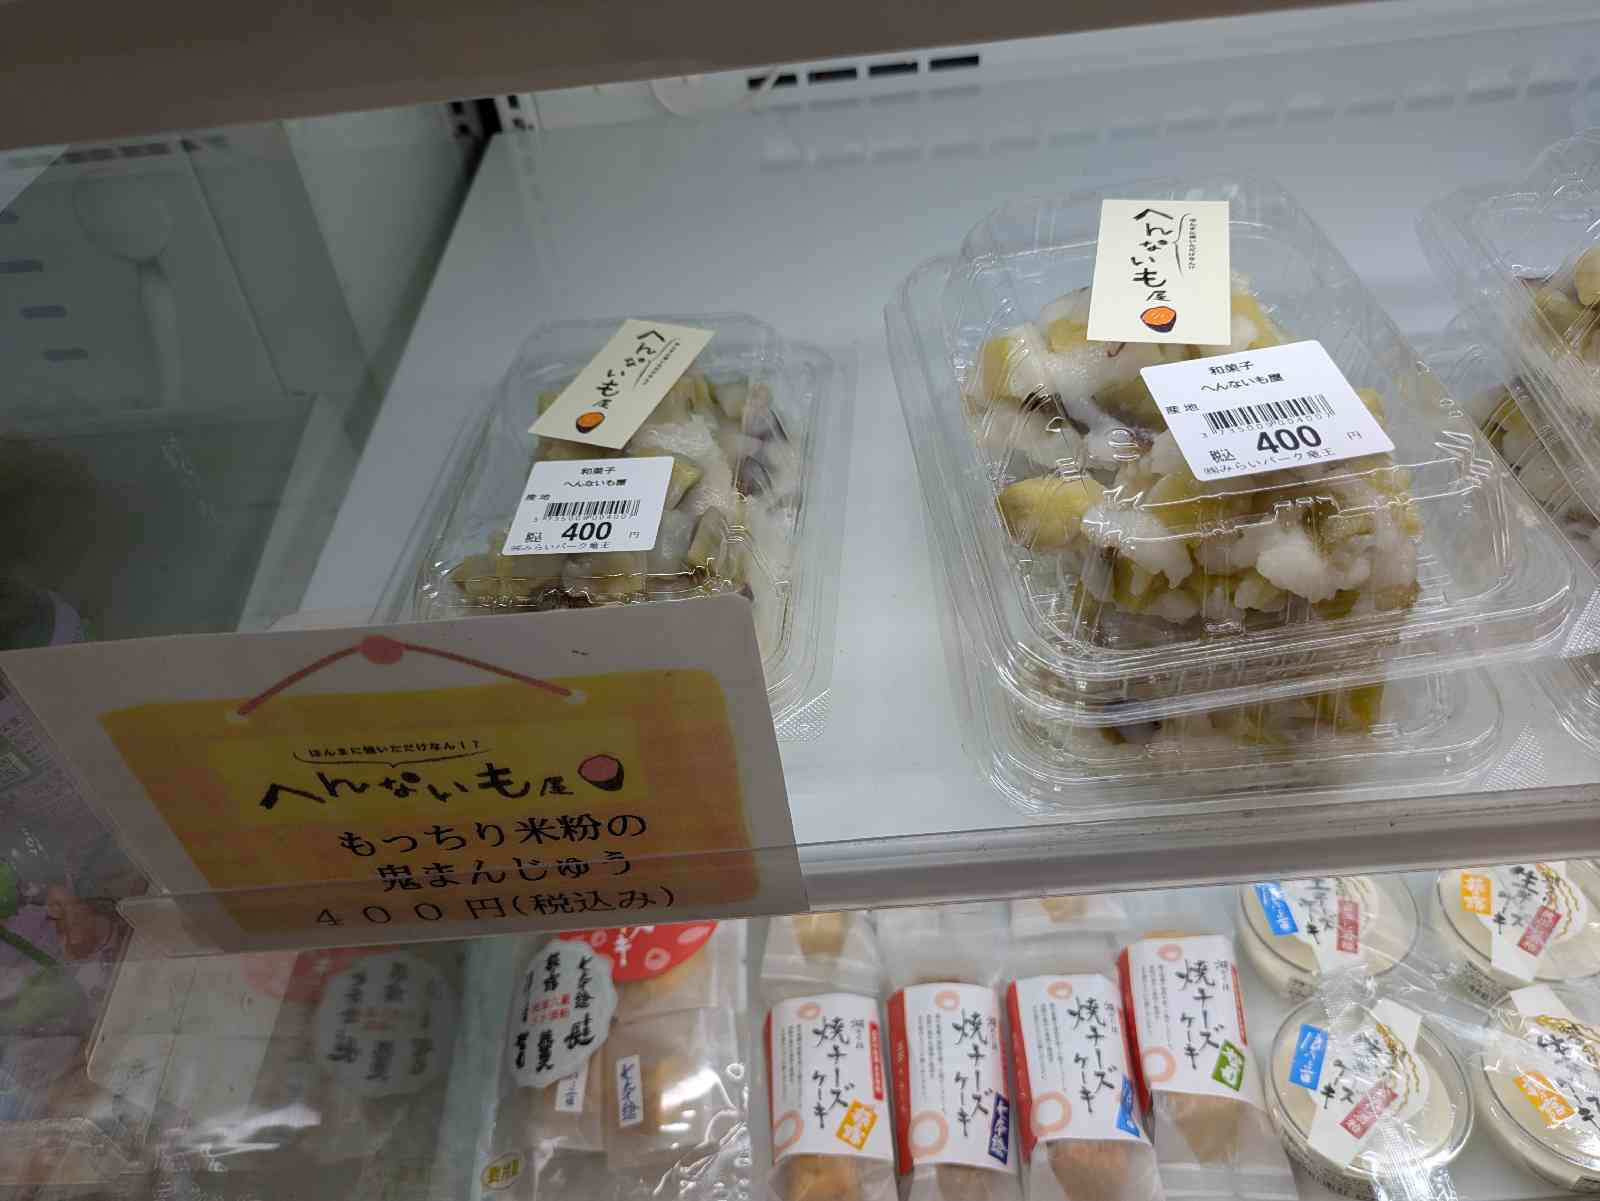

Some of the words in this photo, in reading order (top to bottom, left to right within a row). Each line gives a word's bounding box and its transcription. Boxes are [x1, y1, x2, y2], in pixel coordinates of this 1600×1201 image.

[1130, 208, 1174, 301] へんないも屋
[1200, 373, 1285, 393] へんないも屋
[1207, 360, 1254, 376] 和菓子
[1256, 425, 1322, 455] 400
[1346, 430, 1362, 441] 円
[561, 522, 612, 541] 400
[259, 762, 574, 809] へんないも屋
[338, 813, 647, 858] もっちり米粉の
[376, 850, 632, 892] 鬼まんじゅう
